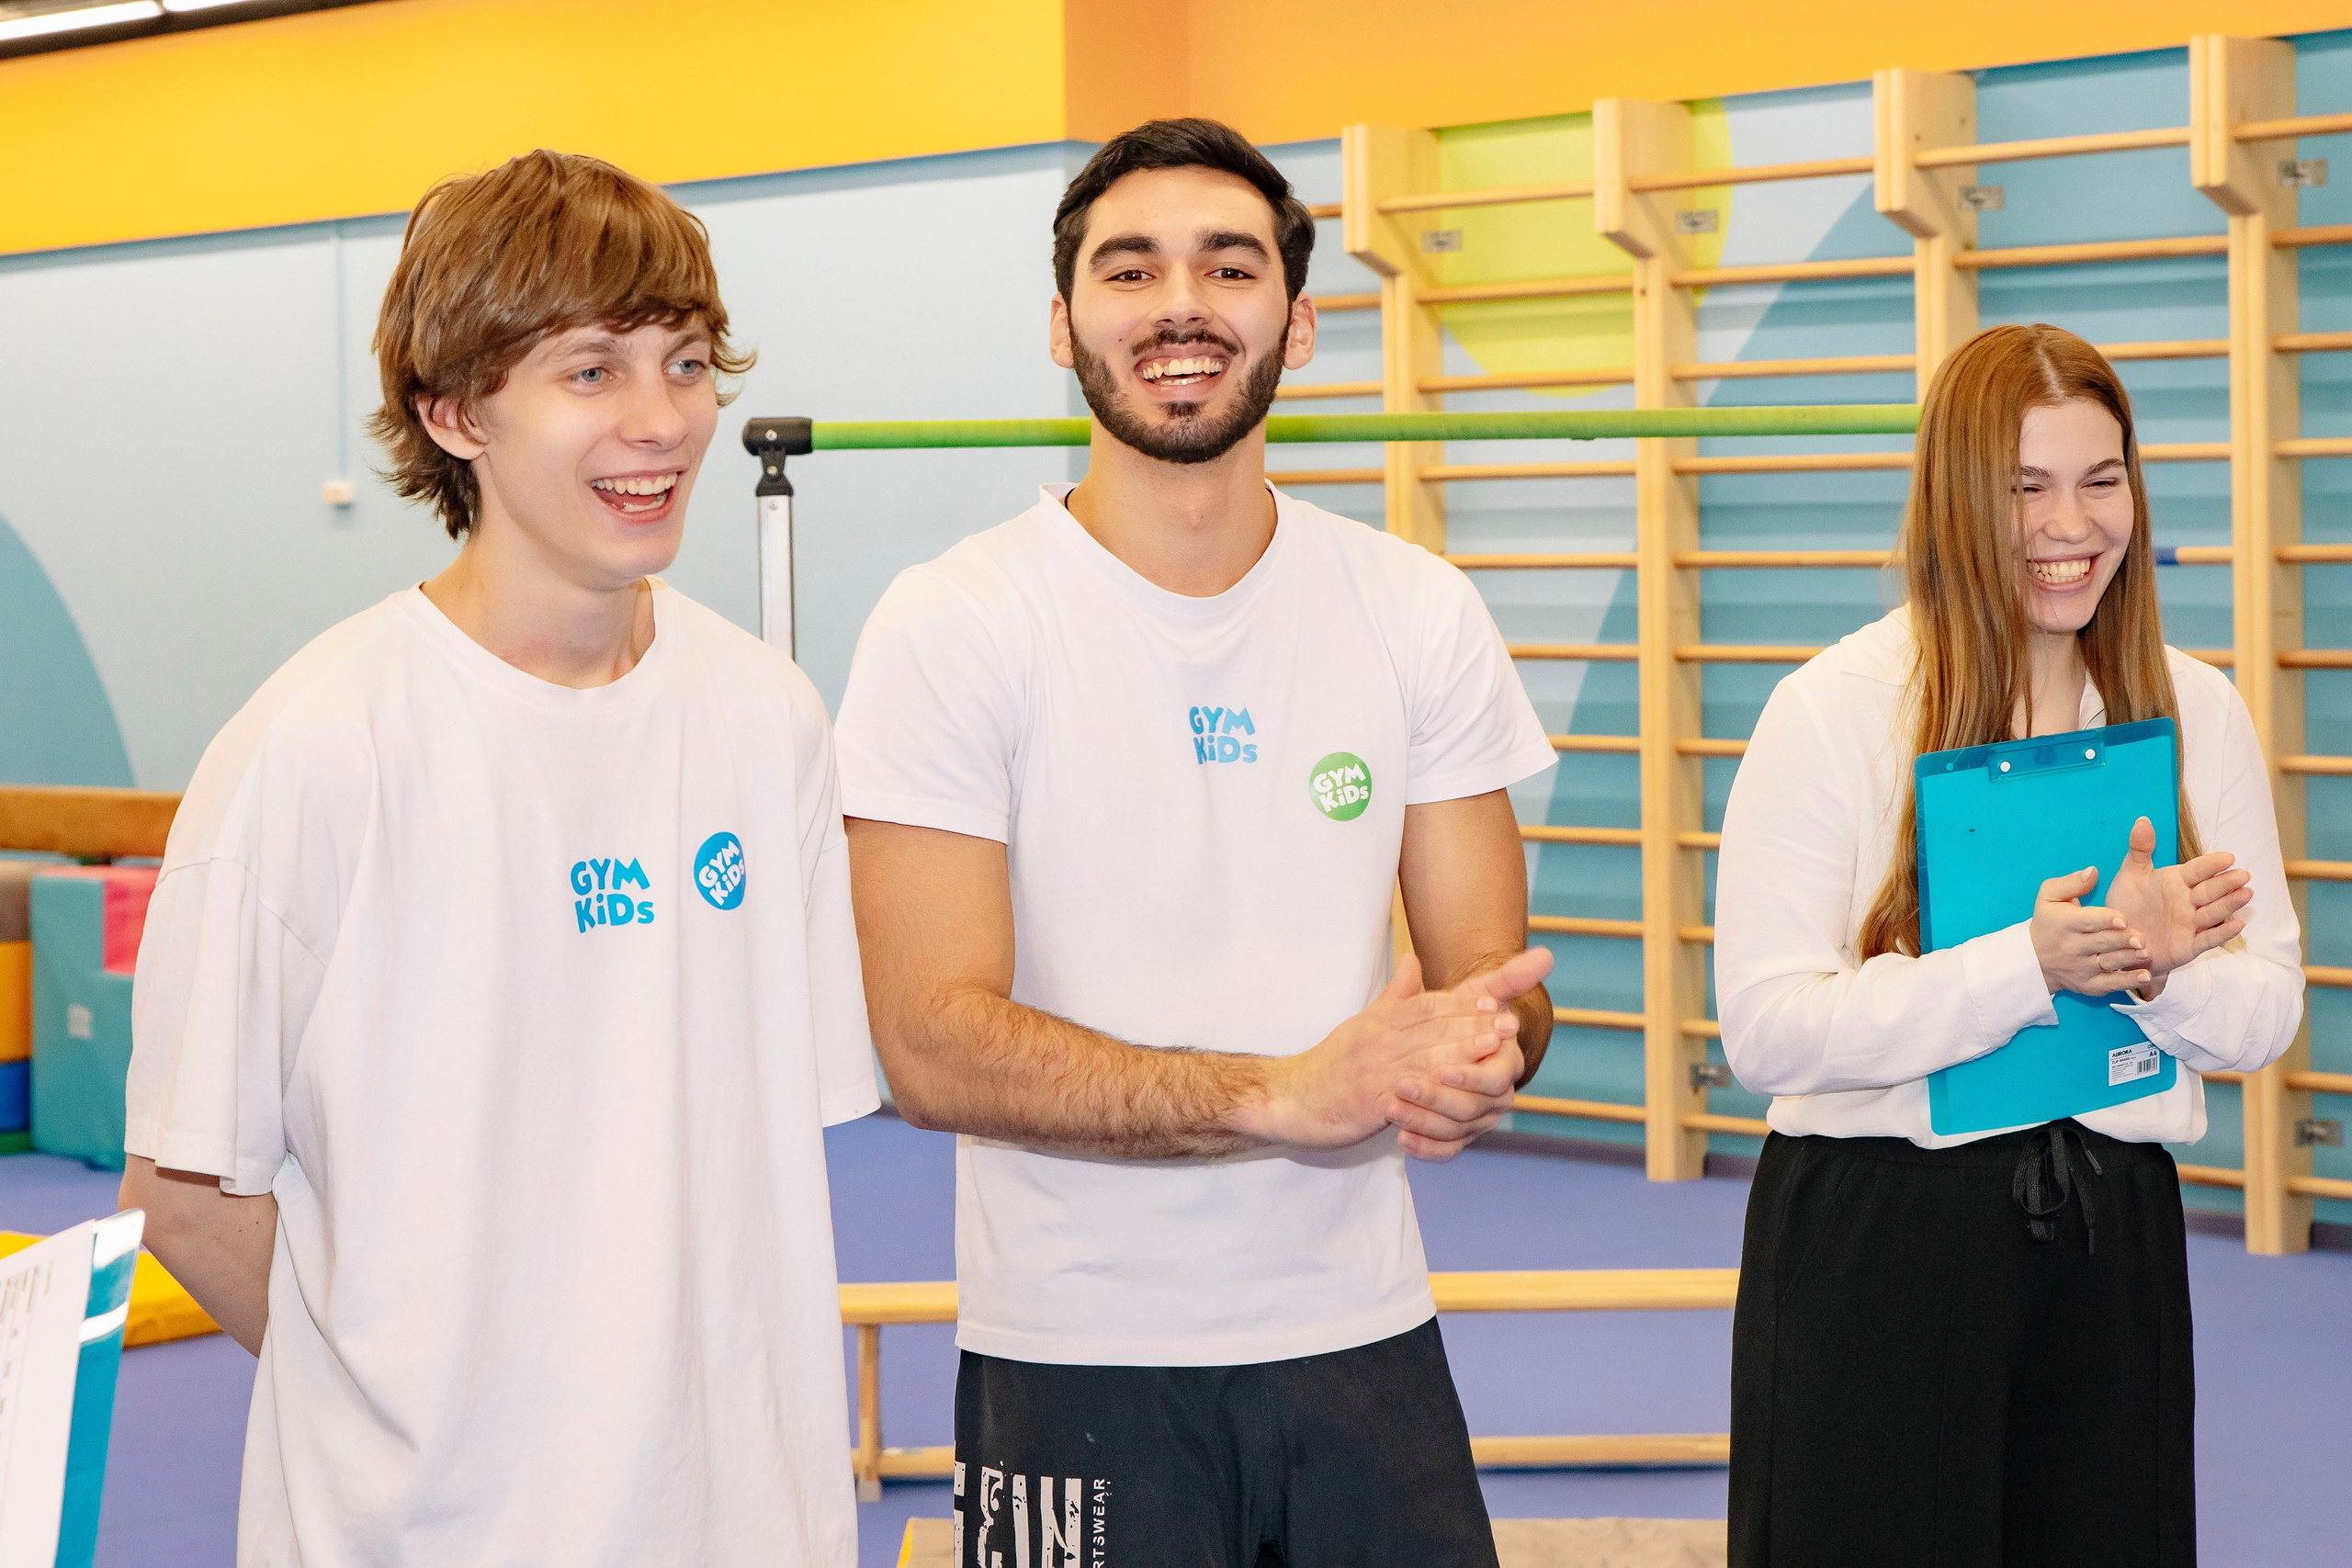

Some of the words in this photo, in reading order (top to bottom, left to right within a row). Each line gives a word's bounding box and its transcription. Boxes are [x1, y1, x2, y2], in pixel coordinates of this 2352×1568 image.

[1189, 705, 1256, 735] GYM
[1313, 763, 1366, 793] GYM
[571, 857, 650, 896] GYM
[698, 840, 741, 888] GYM
[2112, 1049, 2132, 1057] AURORA
